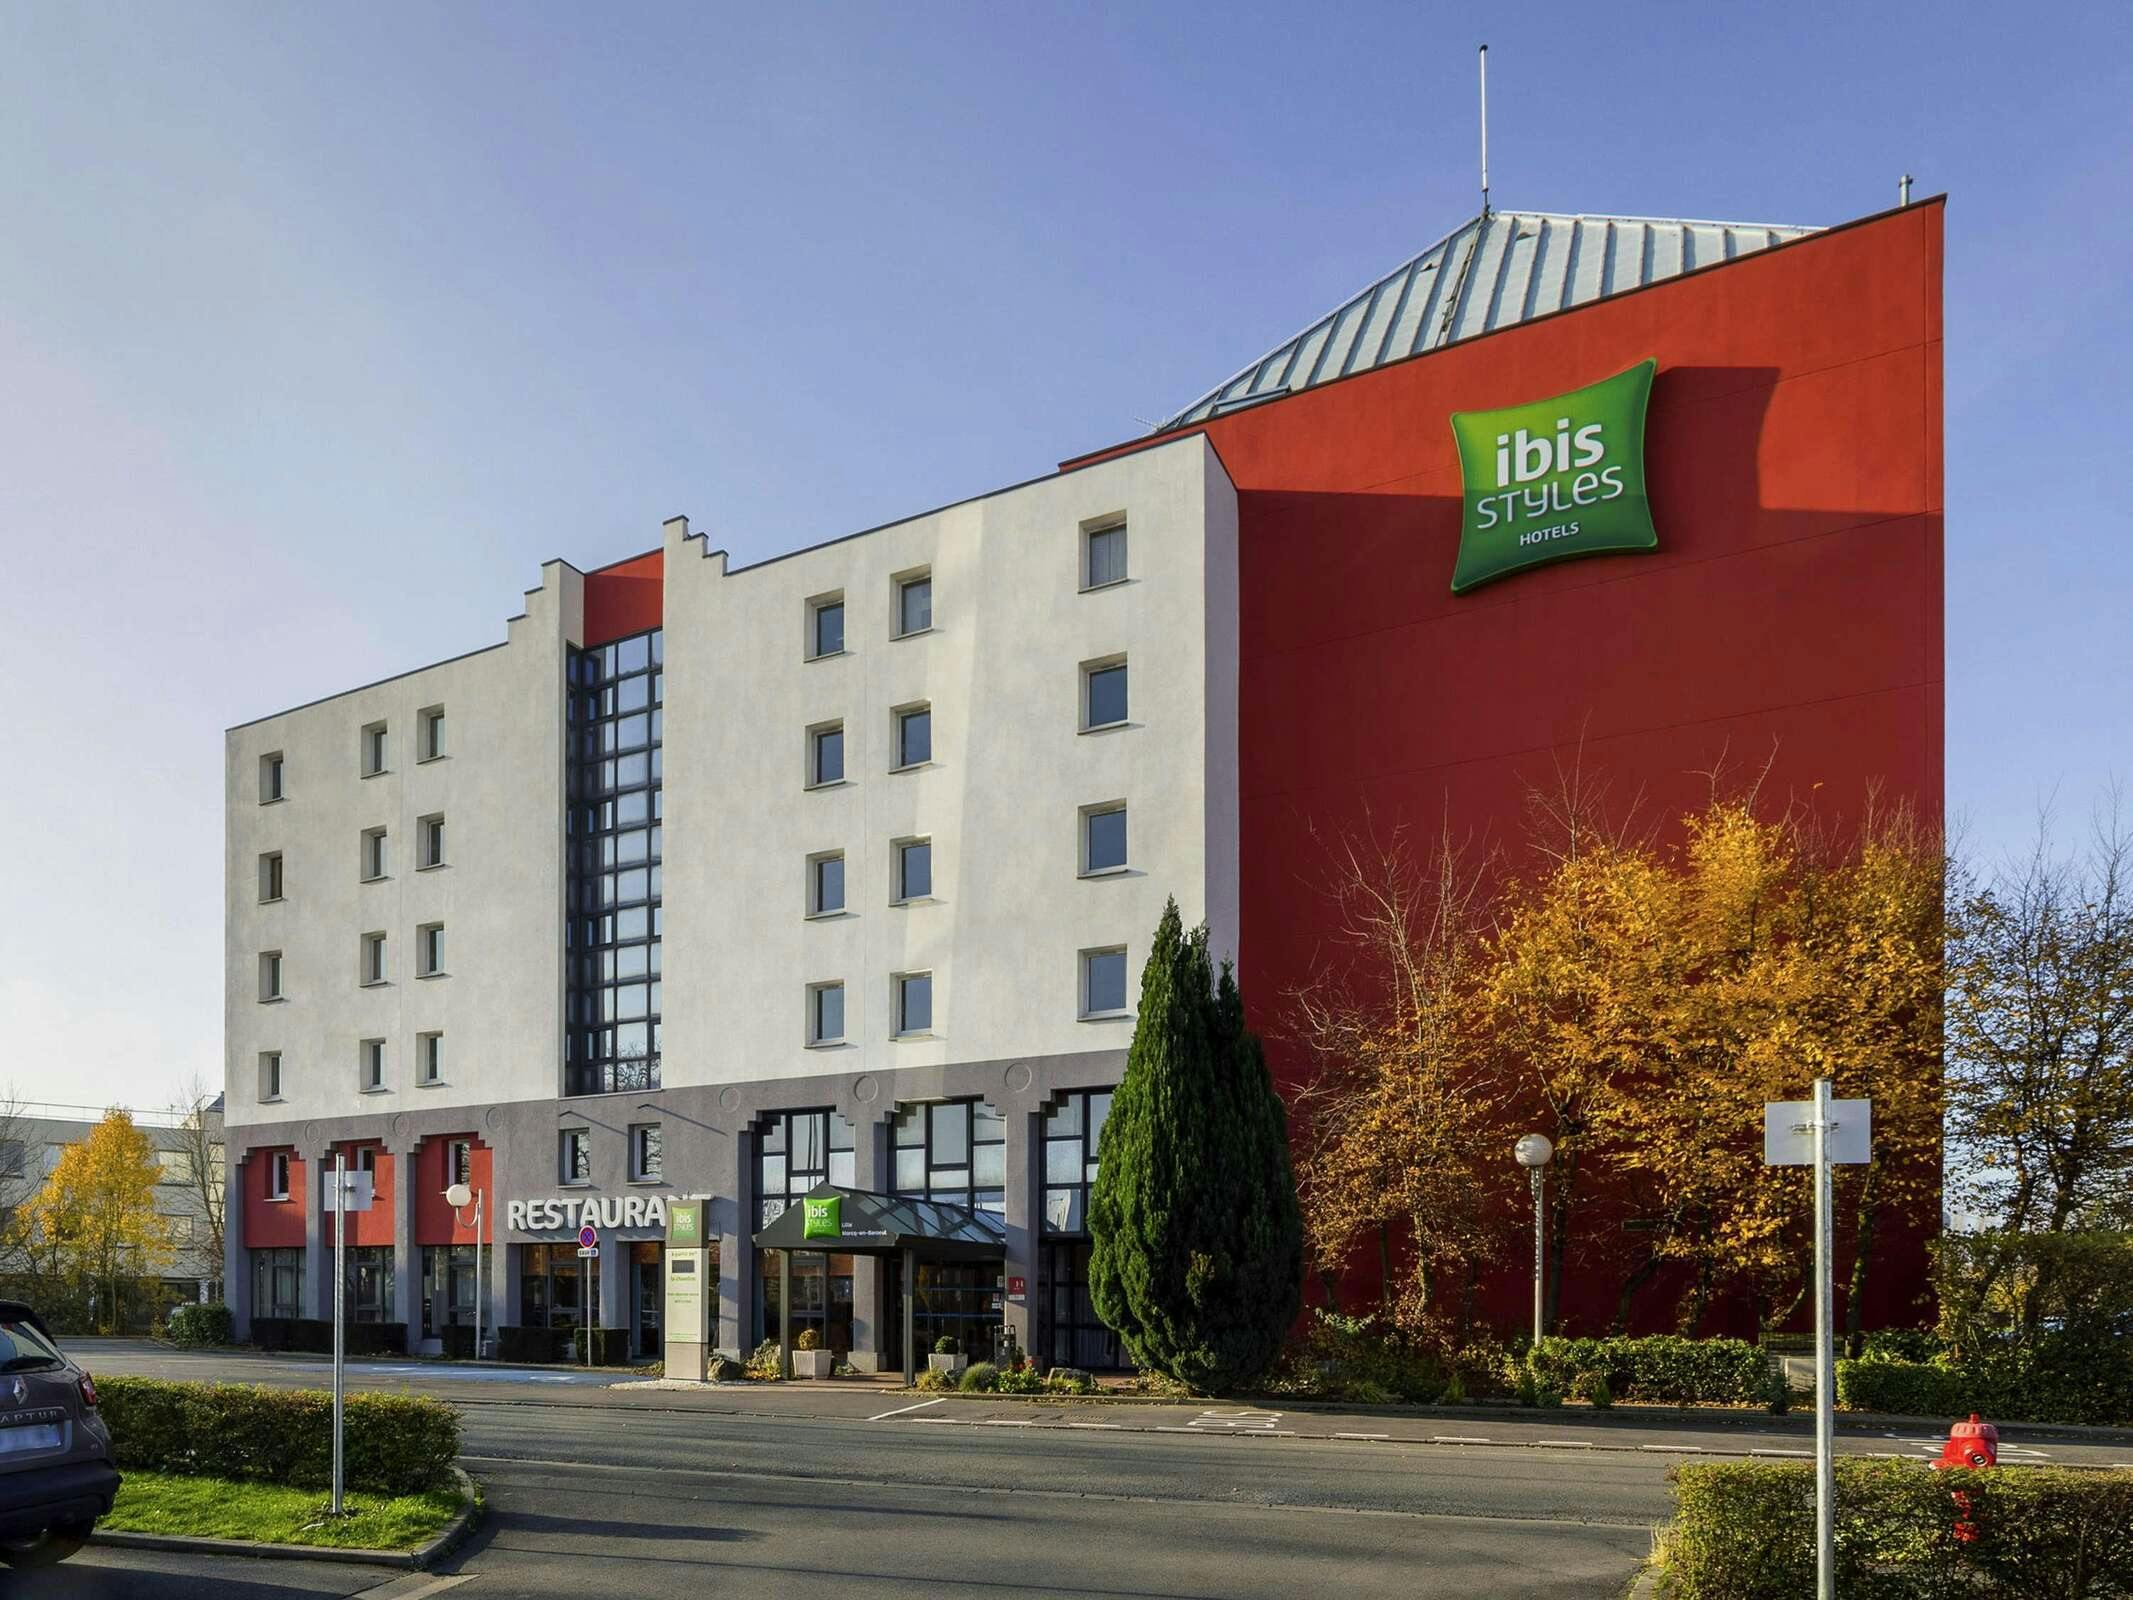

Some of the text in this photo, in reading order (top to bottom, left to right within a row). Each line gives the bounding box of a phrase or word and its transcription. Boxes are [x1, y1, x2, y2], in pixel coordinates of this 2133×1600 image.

[1496, 418, 1605, 487] ibis
[1519, 521, 1580, 546] HOTELS
[507, 1194, 711, 1230] RESTAURA
[807, 1204, 828, 1218] ibis
[0, 1410, 57, 1423] APTUR
